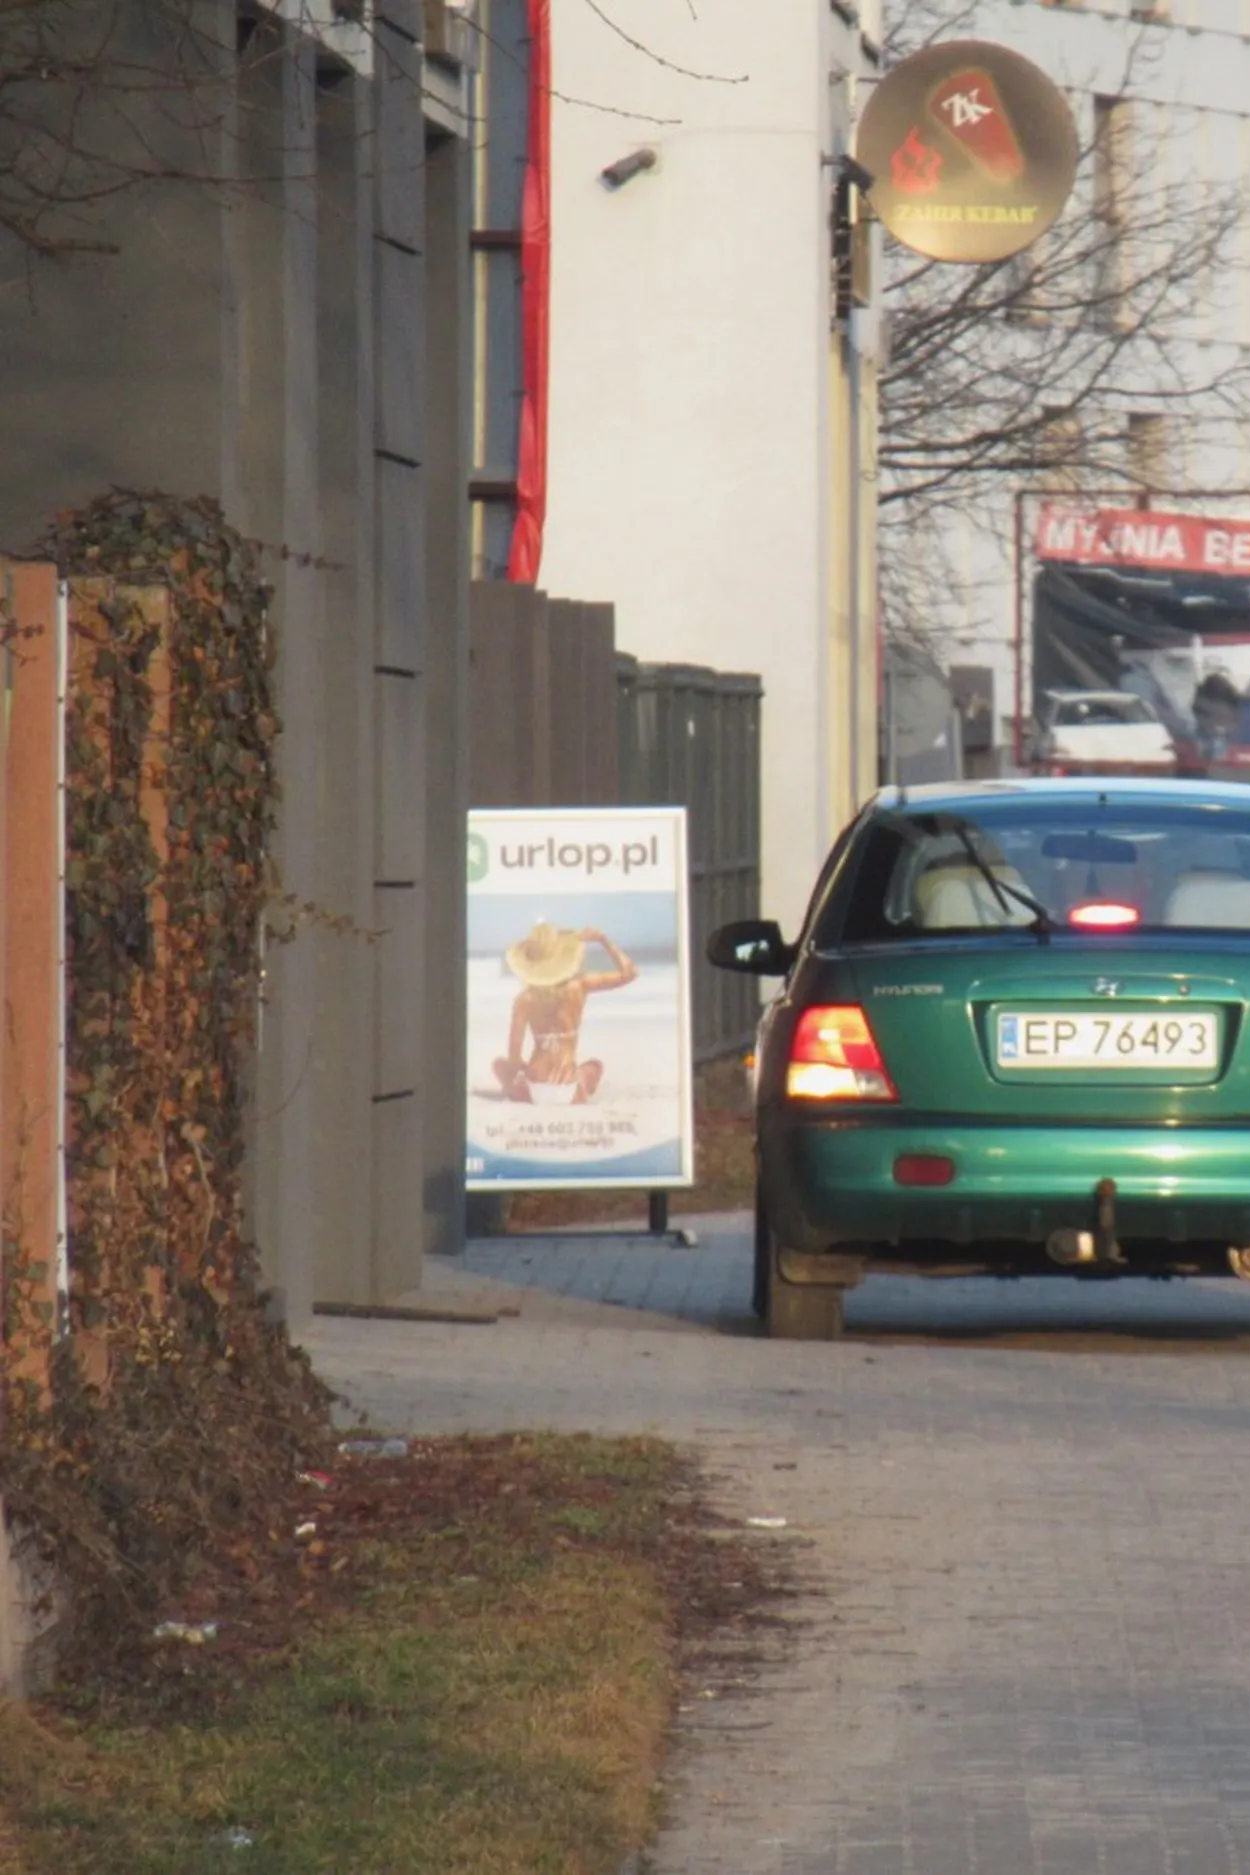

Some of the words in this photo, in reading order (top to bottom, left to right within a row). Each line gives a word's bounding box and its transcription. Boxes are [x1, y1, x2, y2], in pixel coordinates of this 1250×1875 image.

[1045, 516, 1186, 560] MYJNIA
[500, 835, 659, 876] urlop.pl
[1024, 1019, 1078, 1056] EP
[1092, 1019, 1208, 1056] 76493
